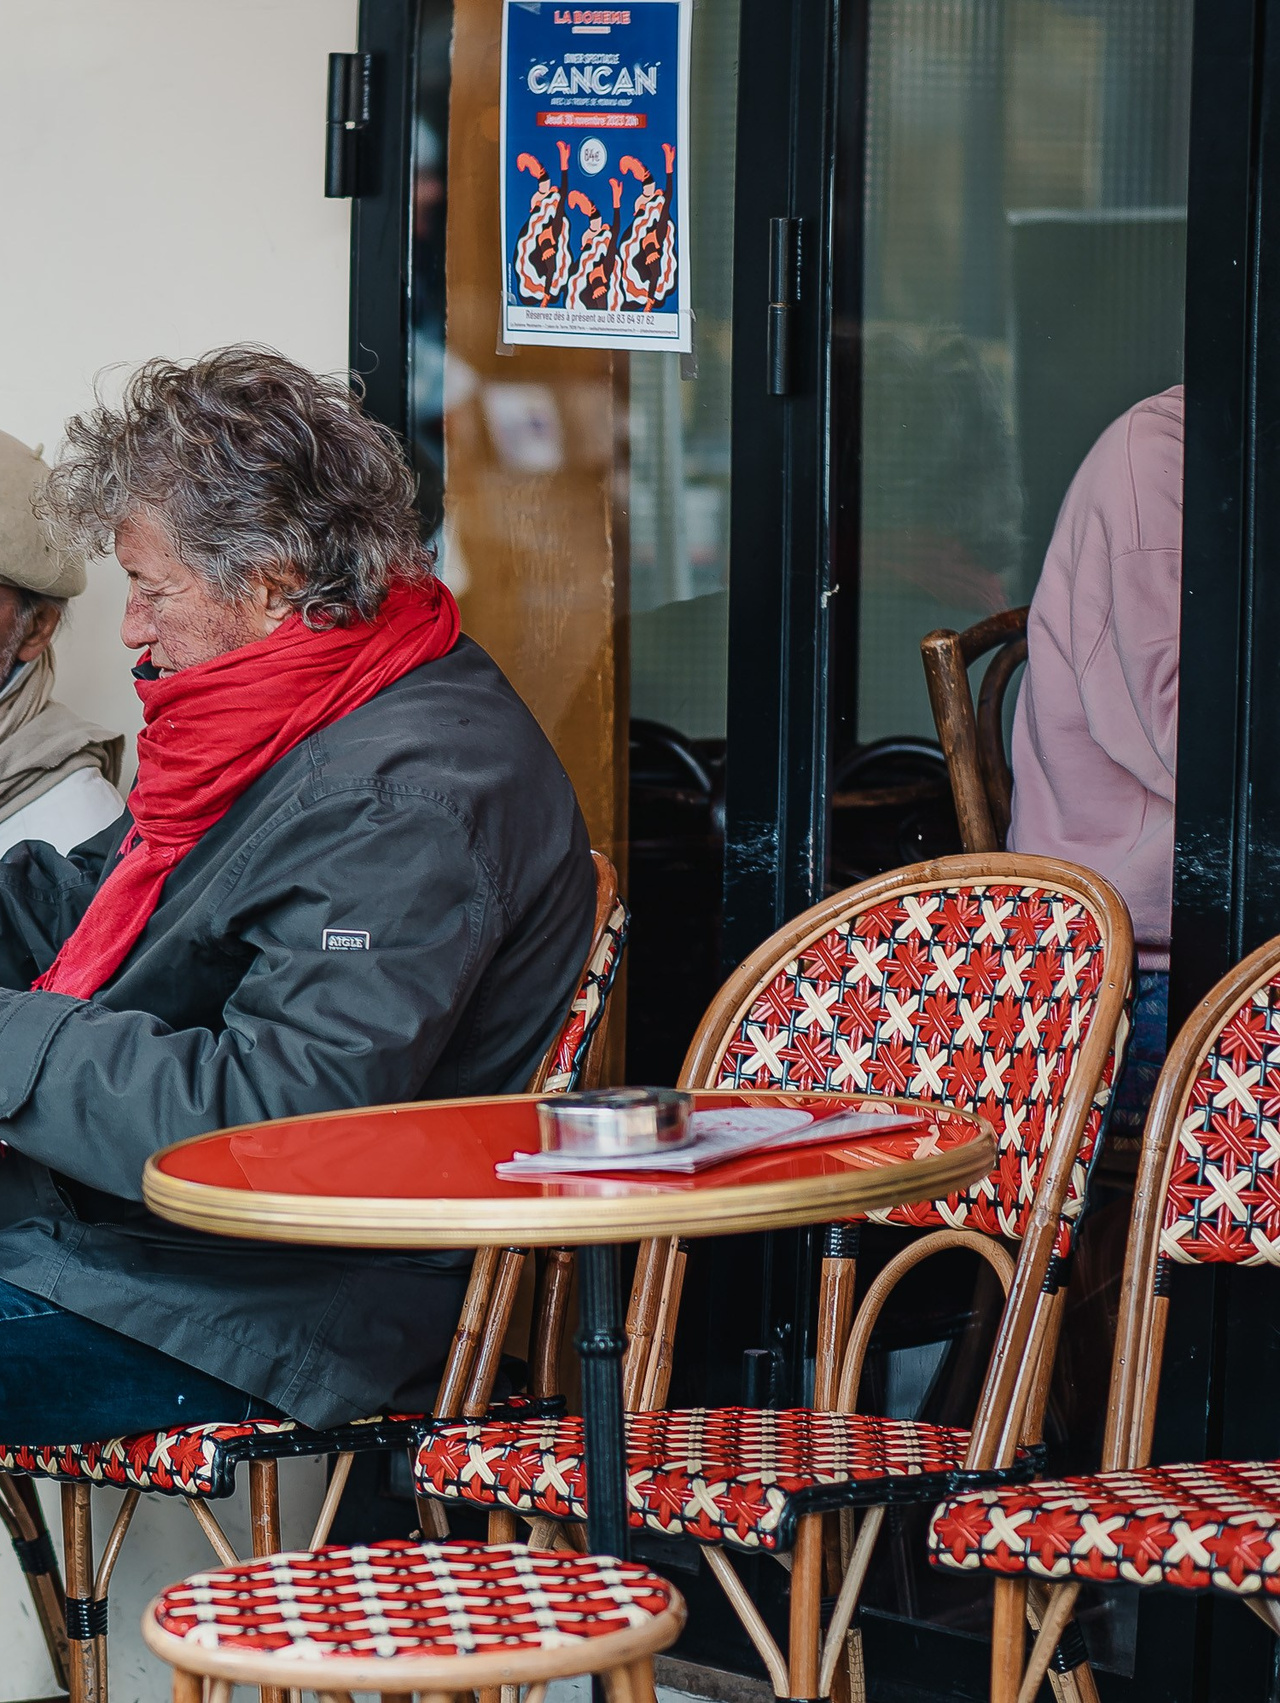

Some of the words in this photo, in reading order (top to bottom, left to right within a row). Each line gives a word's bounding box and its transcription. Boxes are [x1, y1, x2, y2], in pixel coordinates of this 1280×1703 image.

[554, 10, 572, 24] LA
[573, 10, 631, 24] BOHEME
[528, 65, 657, 95] CANCAN
[544, 114, 563, 125] Jeudi
[574, 115, 606, 126] novembre
[525, 309, 552, 320] Réservez
[554, 311, 565, 321] dès
[571, 311, 596, 324] présent
[607, 313, 615, 323] 06
[328, 936, 364, 948] AIGLE
